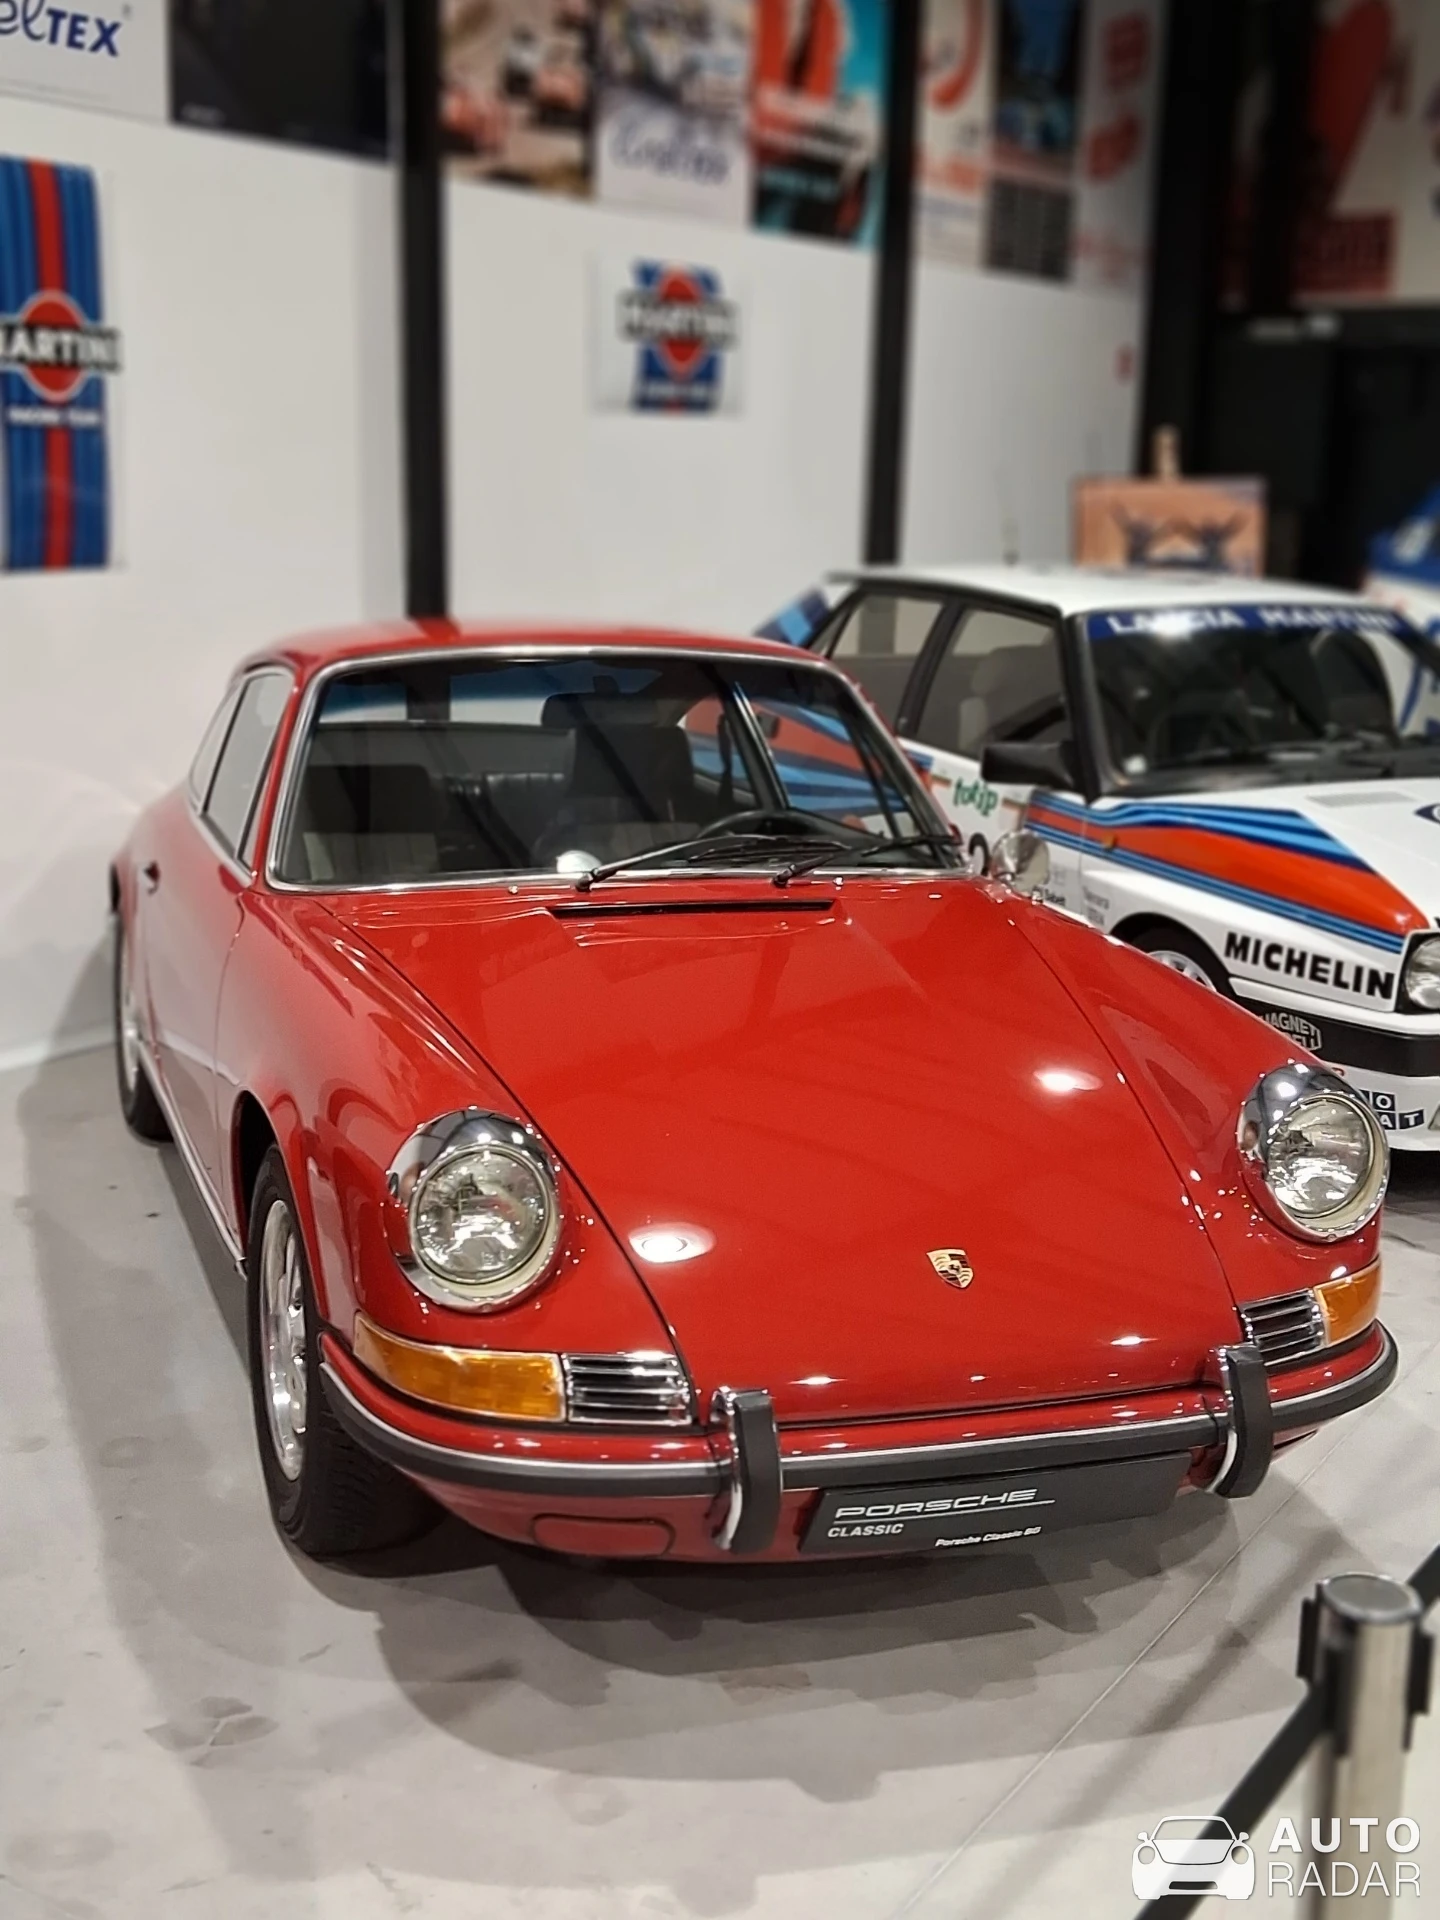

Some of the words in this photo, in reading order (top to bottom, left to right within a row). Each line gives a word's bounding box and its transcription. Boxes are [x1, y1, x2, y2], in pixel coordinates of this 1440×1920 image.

[1225, 931, 1395, 1000] MICHELIN
[834, 1488, 1038, 1519] PORSCHE
[827, 1523, 904, 1538] CLASSIC
